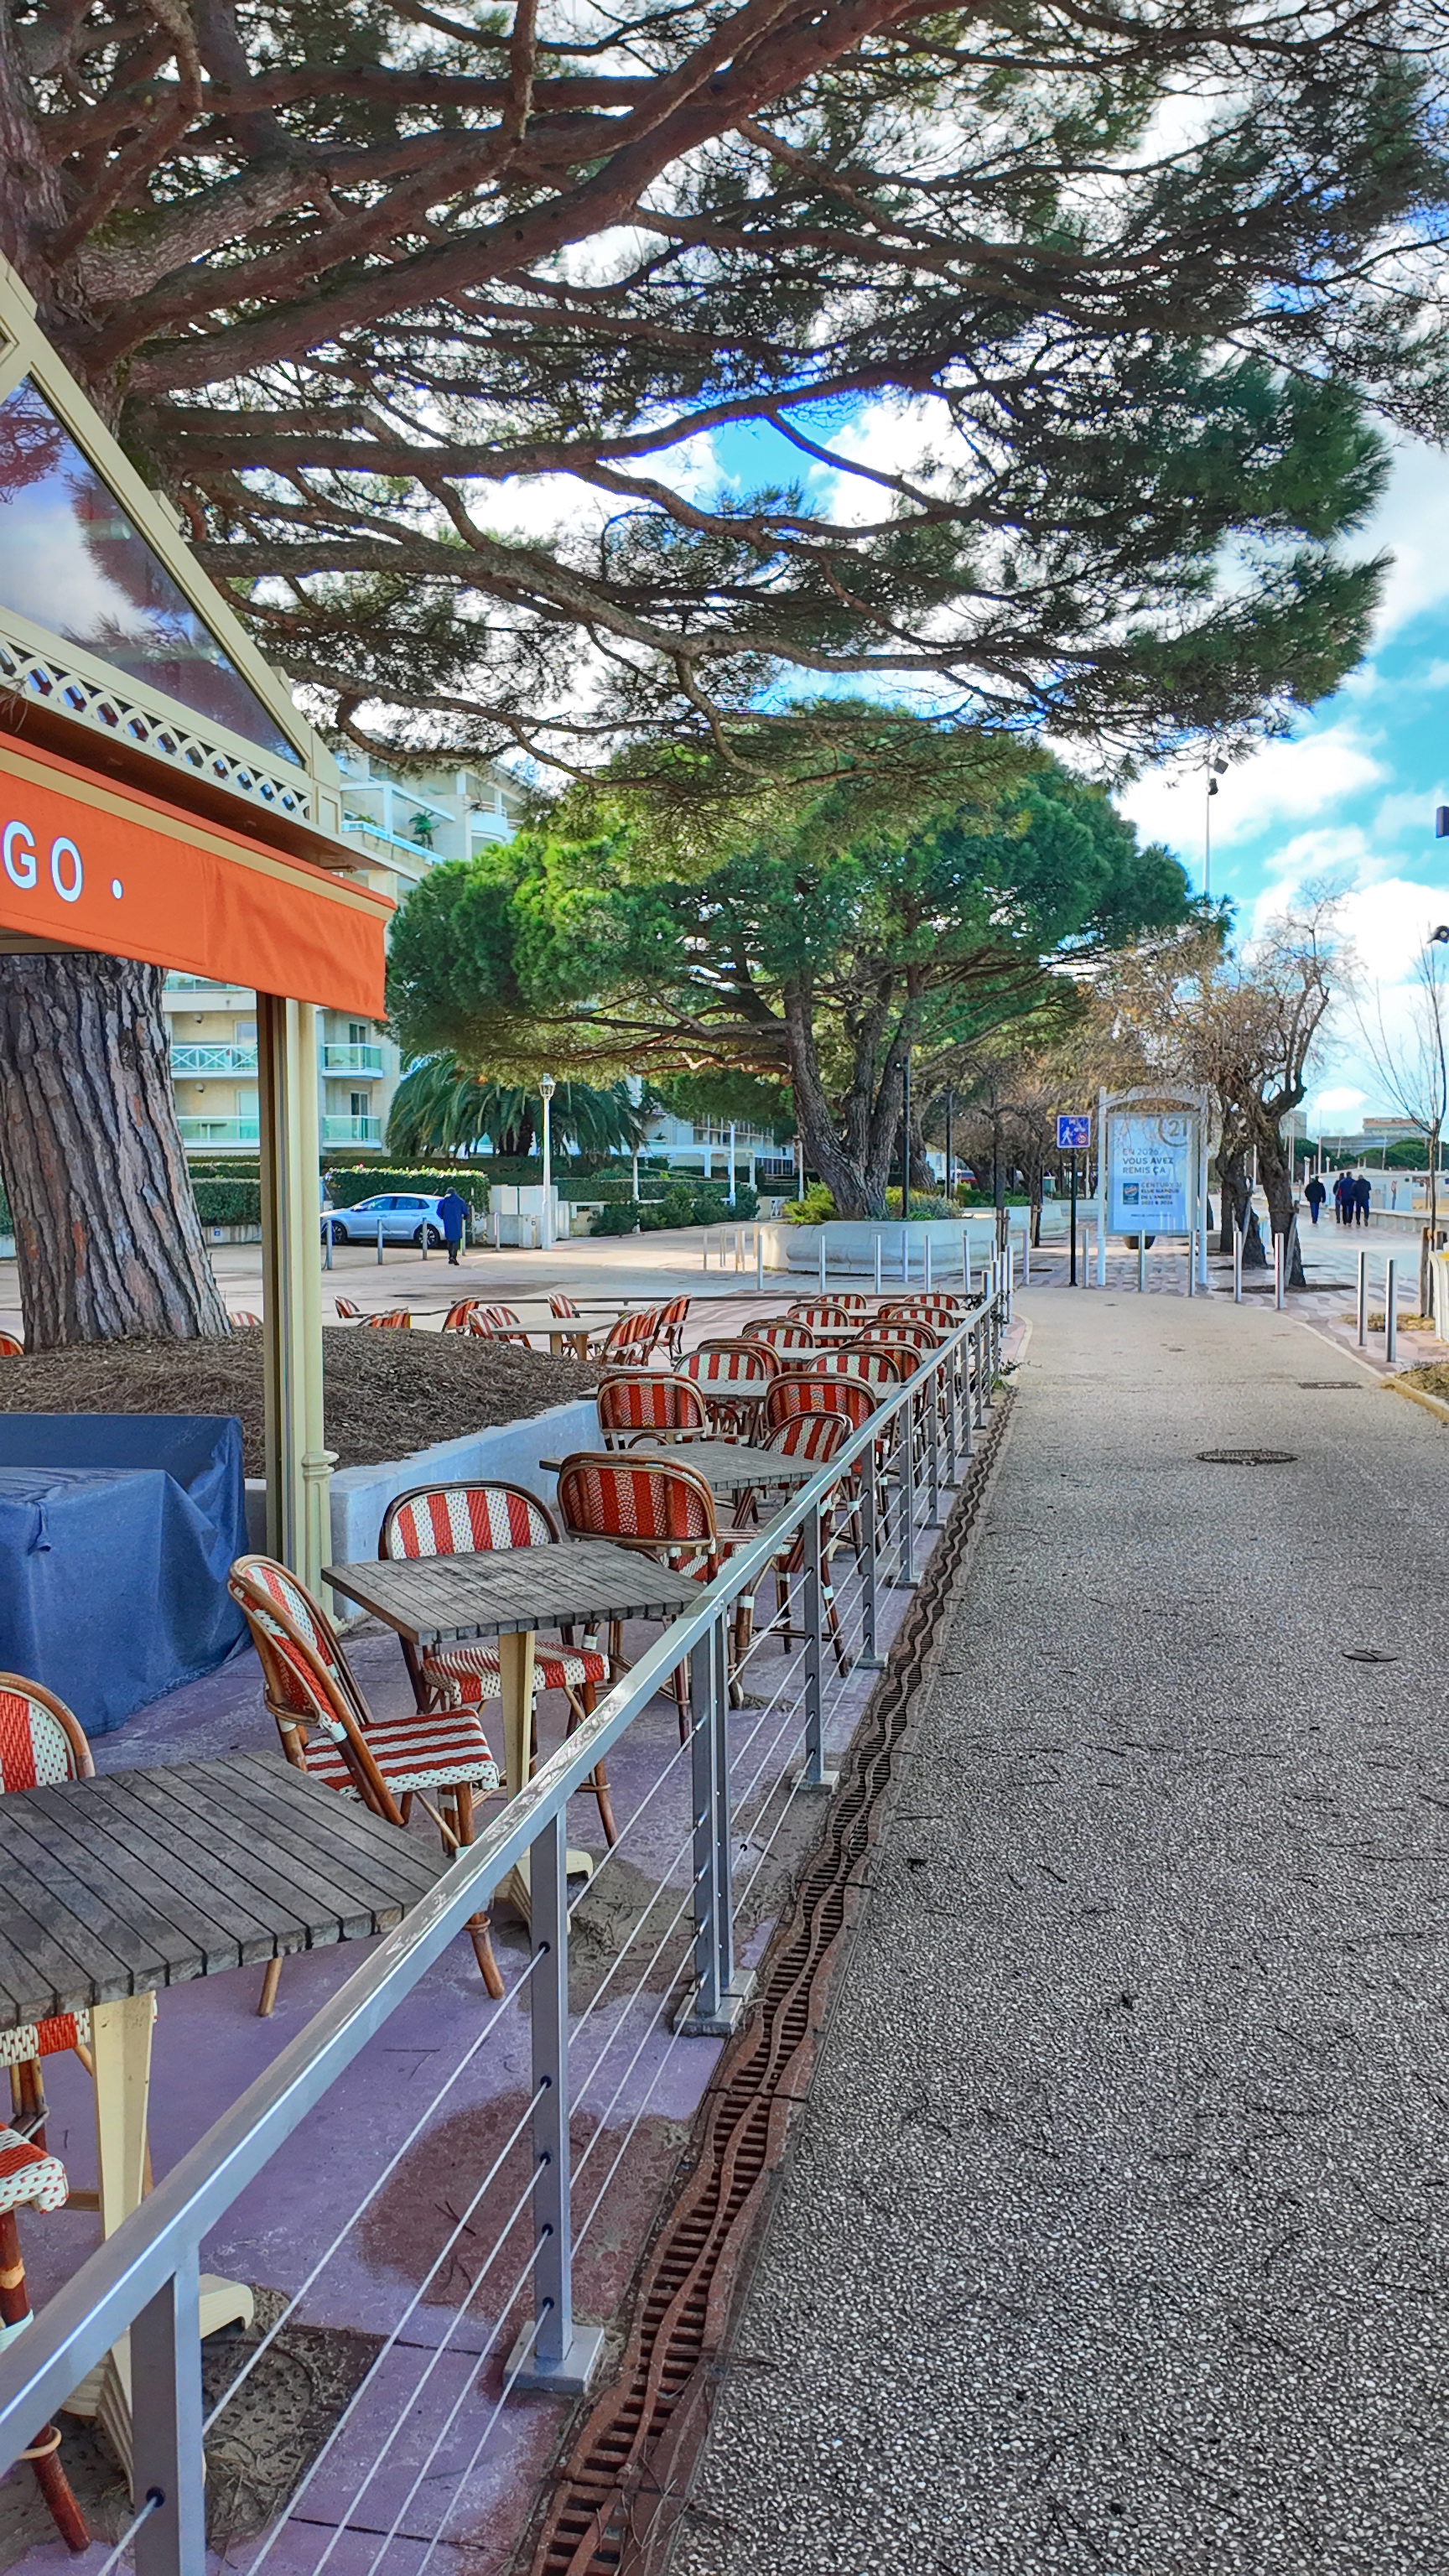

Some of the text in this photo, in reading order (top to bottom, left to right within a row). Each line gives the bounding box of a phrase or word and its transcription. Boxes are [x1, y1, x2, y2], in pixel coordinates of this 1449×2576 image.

[3, 819, 84, 903] GO
[1168, 1119, 1187, 1136] 21
[1153, 1166, 1166, 1176] ÇA
